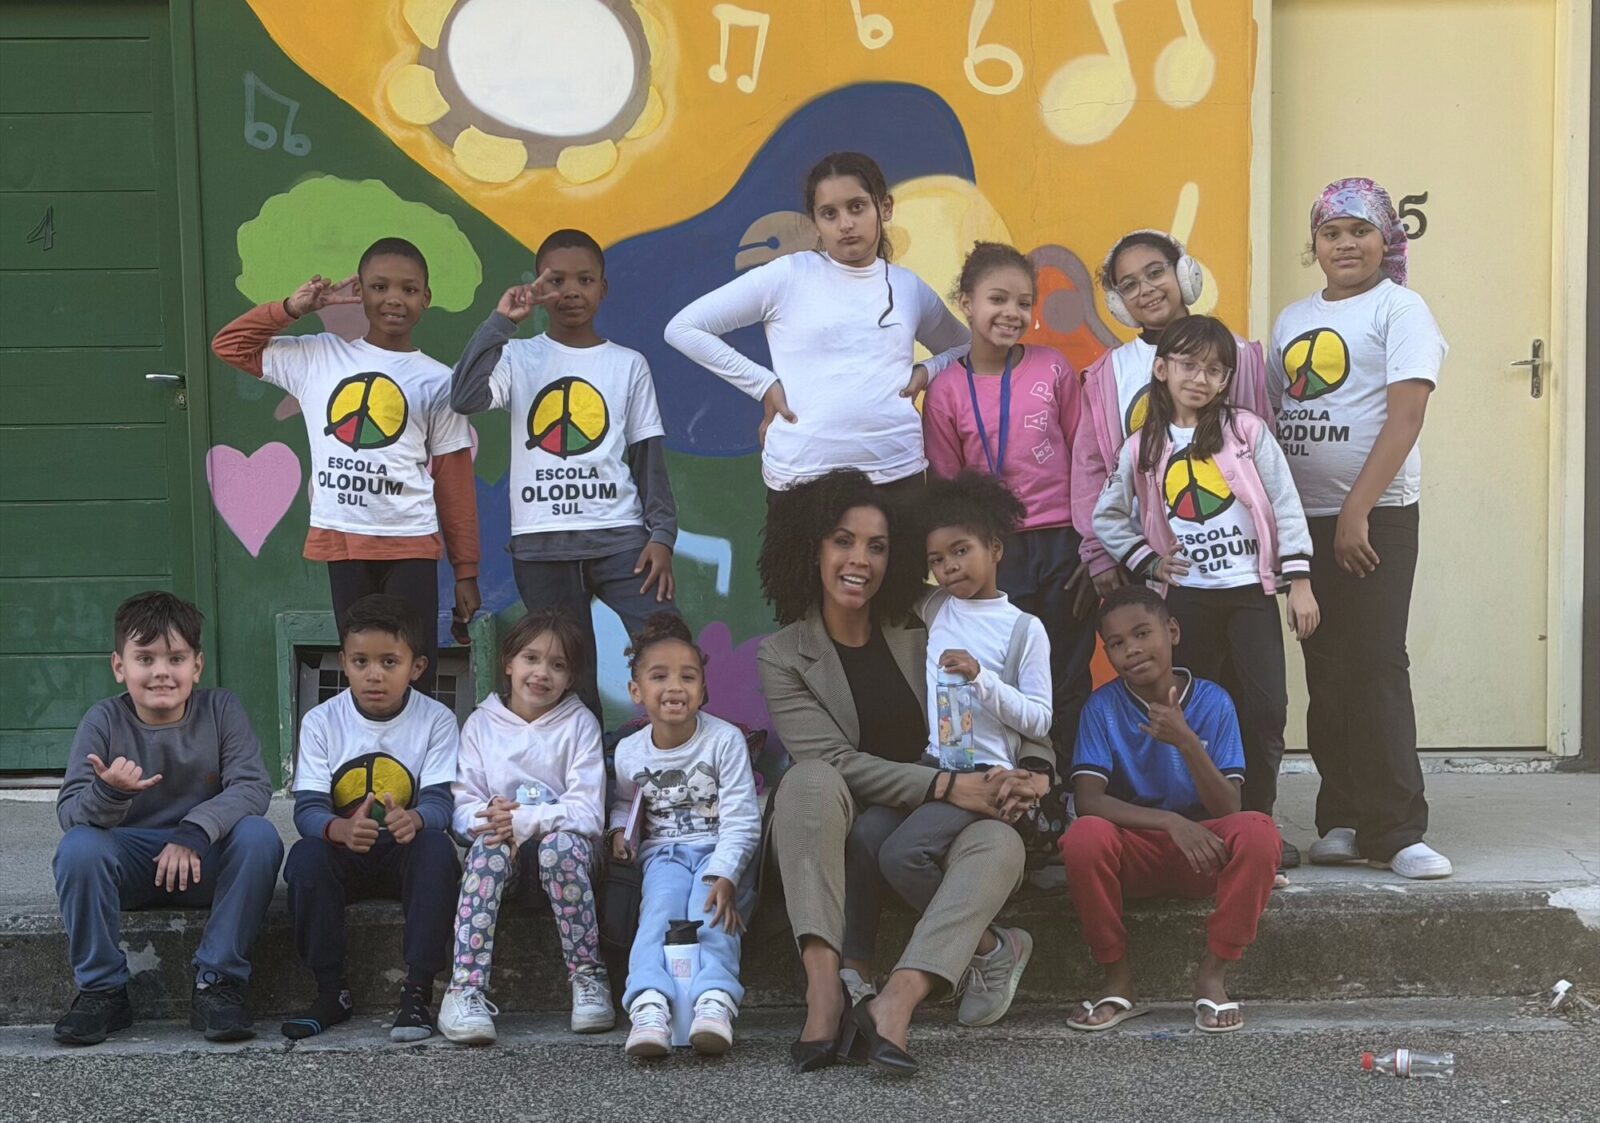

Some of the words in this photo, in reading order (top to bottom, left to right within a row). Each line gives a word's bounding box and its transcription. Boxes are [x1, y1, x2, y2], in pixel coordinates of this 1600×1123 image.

[1399, 191, 1428, 240] 5
[26, 205, 57, 251] 4
[1279, 409, 1331, 421] SCOLA
[1276, 422, 1350, 442] ODUM
[1283, 443, 1309, 456] SUL
[328, 456, 388, 476] ESCOLA
[536, 466, 599, 481] ESCOLA
[318, 470, 404, 496] OLODUM
[521, 482, 617, 503] OLODUM
[337, 492, 368, 507] SUL
[552, 502, 584, 516] SUL
[1182, 539, 1259, 563] ODUM
[1199, 559, 1232, 574] SUL
